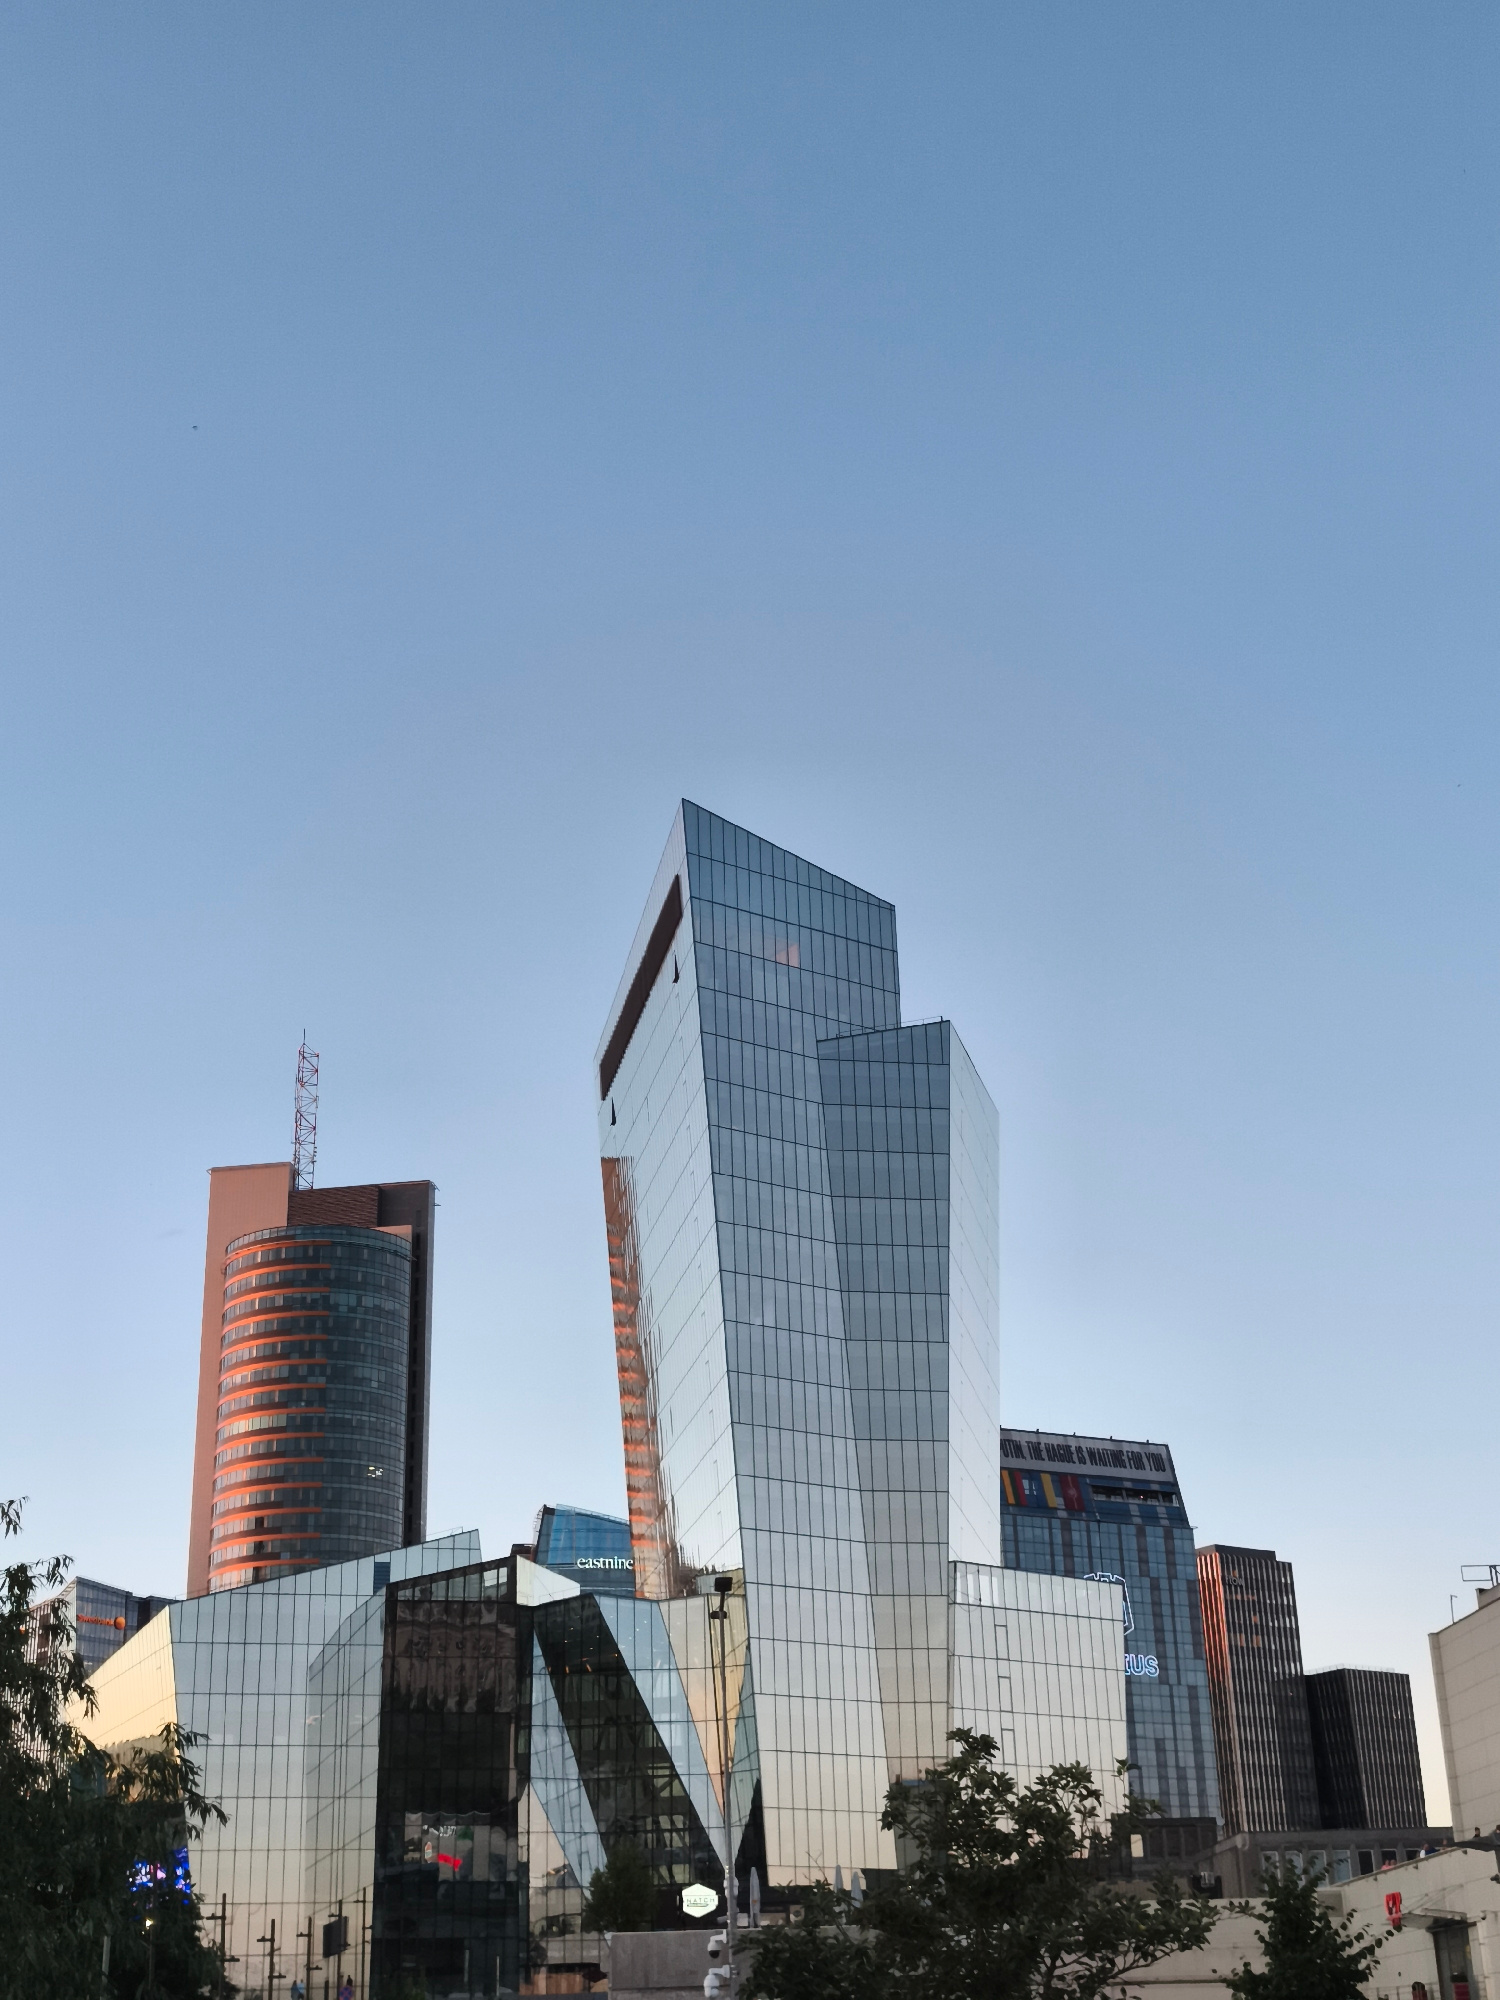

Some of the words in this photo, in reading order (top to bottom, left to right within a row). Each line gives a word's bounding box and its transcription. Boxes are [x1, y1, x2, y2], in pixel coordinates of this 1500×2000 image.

[1025, 1441, 1045, 1461] THE
[1044, 1443, 1076, 1464] HAGUE
[1075, 1446, 1087, 1465] IS
[1086, 1446, 1127, 1469] WAITING
[1126, 1450, 1146, 1471] FOR
[1144, 1451, 1166, 1472] YOU
[577, 1555, 634, 1570] eastnine
